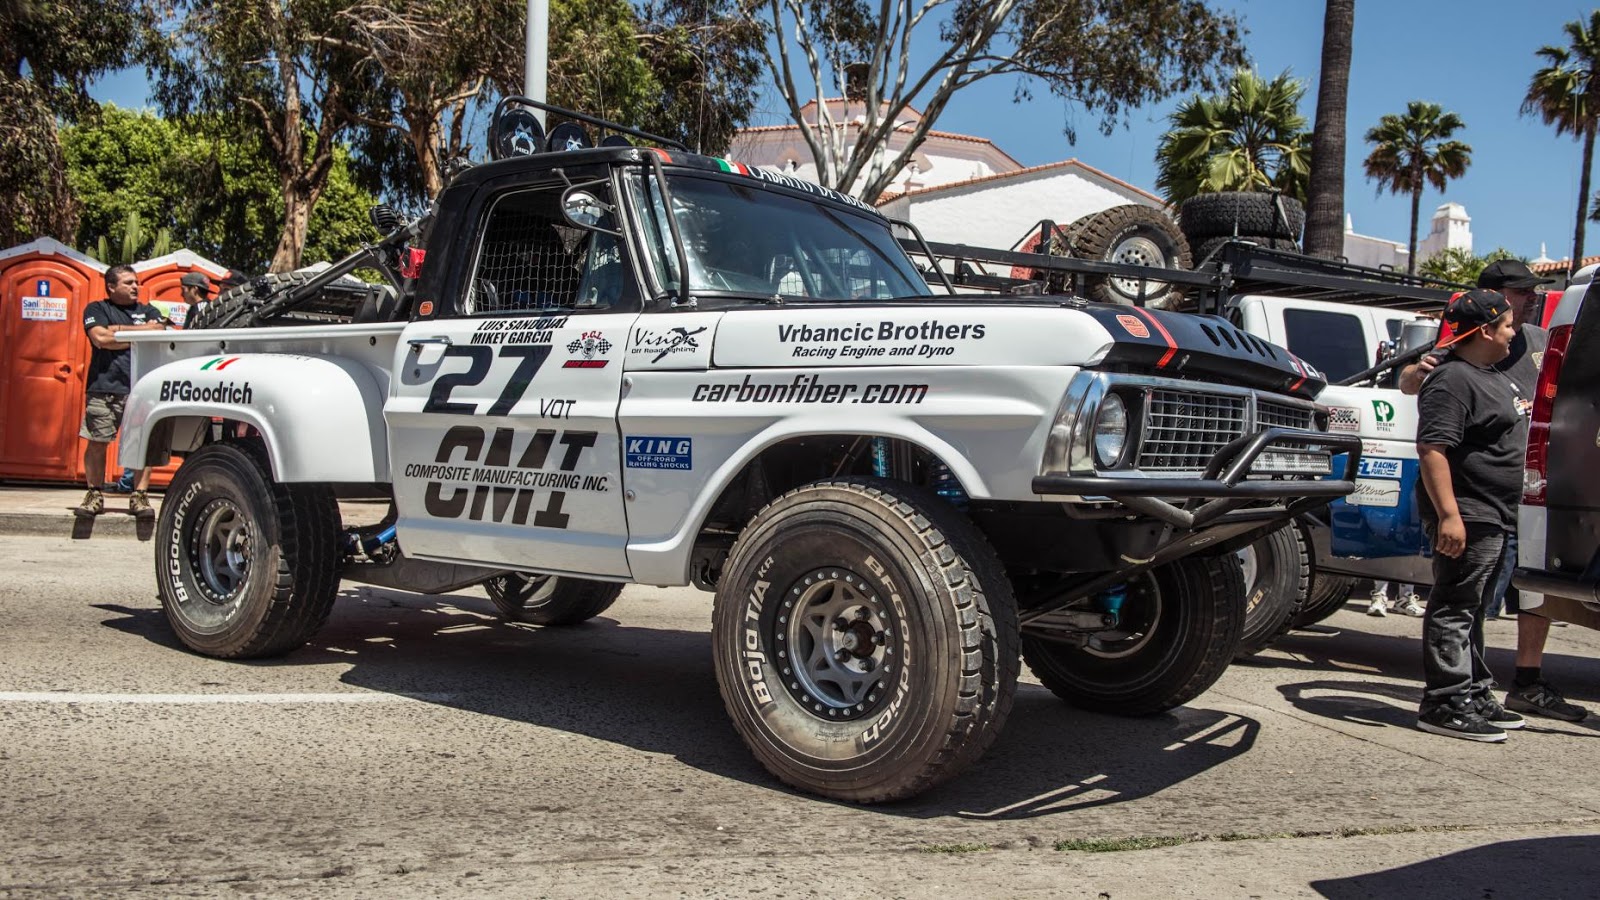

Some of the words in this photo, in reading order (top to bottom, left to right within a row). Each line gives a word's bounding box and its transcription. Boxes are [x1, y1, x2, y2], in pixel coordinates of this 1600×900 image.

[477, 321, 507, 331] LUIS
[505, 316, 569, 331] SANDOVAL
[778, 322, 874, 343] Vrbancic
[877, 320, 986, 342] Brothers
[470, 331, 508, 344] MIKEY
[507, 330, 554, 344] GARCIA
[792, 346, 837, 360] Racing
[840, 345, 886, 359] Engine
[888, 344, 917, 356] and
[918, 344, 955, 358] Dyno
[159, 380, 252, 404] BFGoodrich
[422, 344, 553, 417] 27
[692, 374, 929, 405] carbonfiber.com
[540, 398, 577, 420] VOT
[628, 439, 691, 455] KING
[637, 455, 677, 463] OFF-ROAD
[1373, 461, 1399, 470] RACING
[404, 463, 471, 482] COMPOSITE
[472, 467, 580, 490] MANUFACTURING
[582, 475, 609, 492] INC.
[169, 480, 202, 603] BFGoodrich
[757, 555, 775, 578] KR
[862, 555, 911, 744] BFGoodrich
[742, 628, 774, 704] Baja
